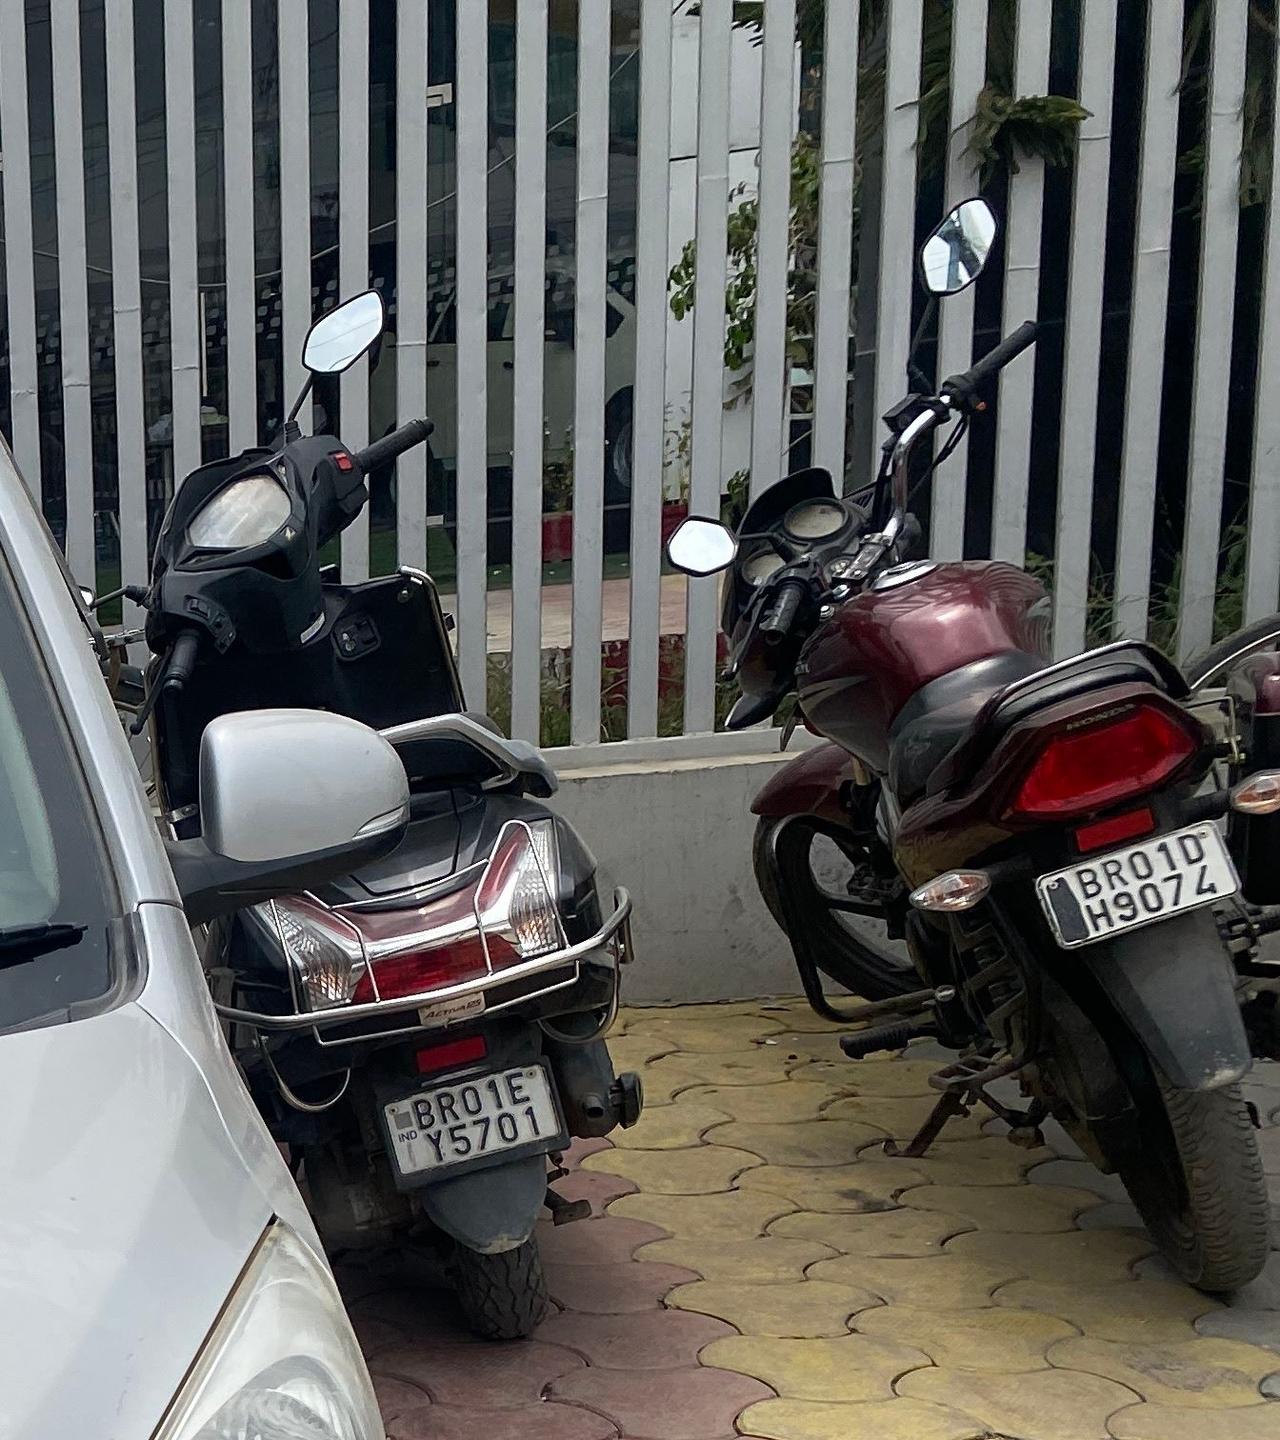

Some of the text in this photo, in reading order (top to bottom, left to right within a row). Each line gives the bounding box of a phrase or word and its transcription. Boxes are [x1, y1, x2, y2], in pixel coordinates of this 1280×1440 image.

[1075, 833, 1205, 900] BR01D
[1085, 865, 1218, 931] H9074
[413, 1071, 531, 1131] BR01E
[398, 1130, 418, 1142] IND
[426, 1106, 540, 1162] Y5701
